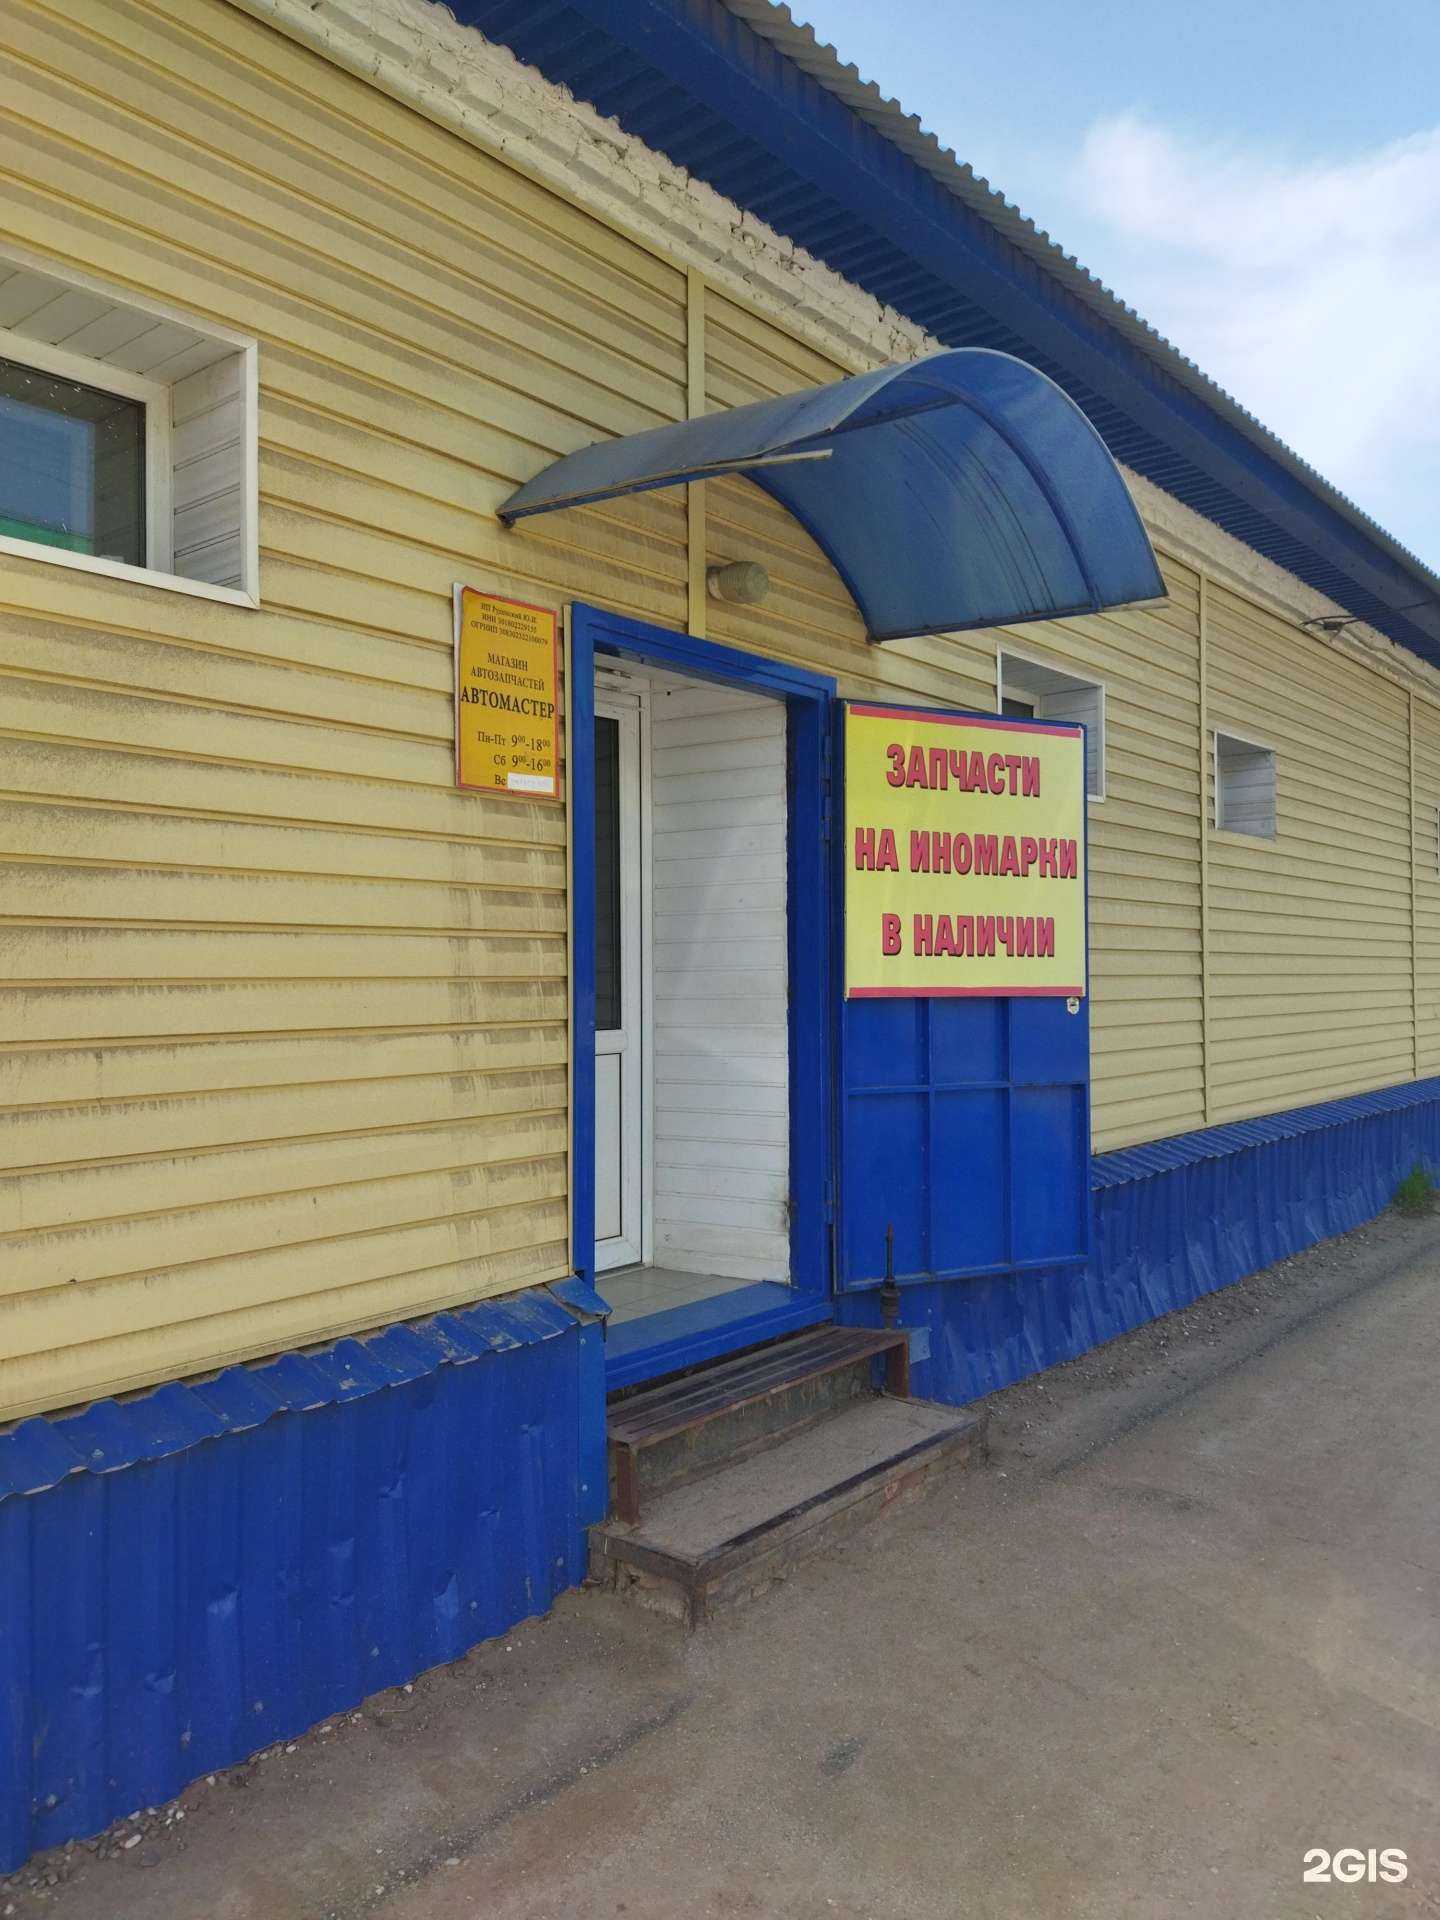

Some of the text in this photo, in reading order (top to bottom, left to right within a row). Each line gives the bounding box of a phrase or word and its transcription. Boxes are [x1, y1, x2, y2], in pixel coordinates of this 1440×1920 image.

[482, 612, 497, 623] ИНН
[487, 652, 528, 672] МАГАЗИН
[470, 665, 545, 692] АВТОЗАПЧАСТЕЙ
[461, 685, 555, 719] АВТОМАСТЕР
[477, 731, 506, 746] Пн-Пт
[493, 754, 507, 767] Сб
[886, 743, 1041, 798] ЗАПЧАСТИ
[494, 774, 507, 786] Вс
[855, 826, 1078, 879] НА ИНОМАРКИ
[881, 912, 1055, 957] В НАЛИЧИИ
